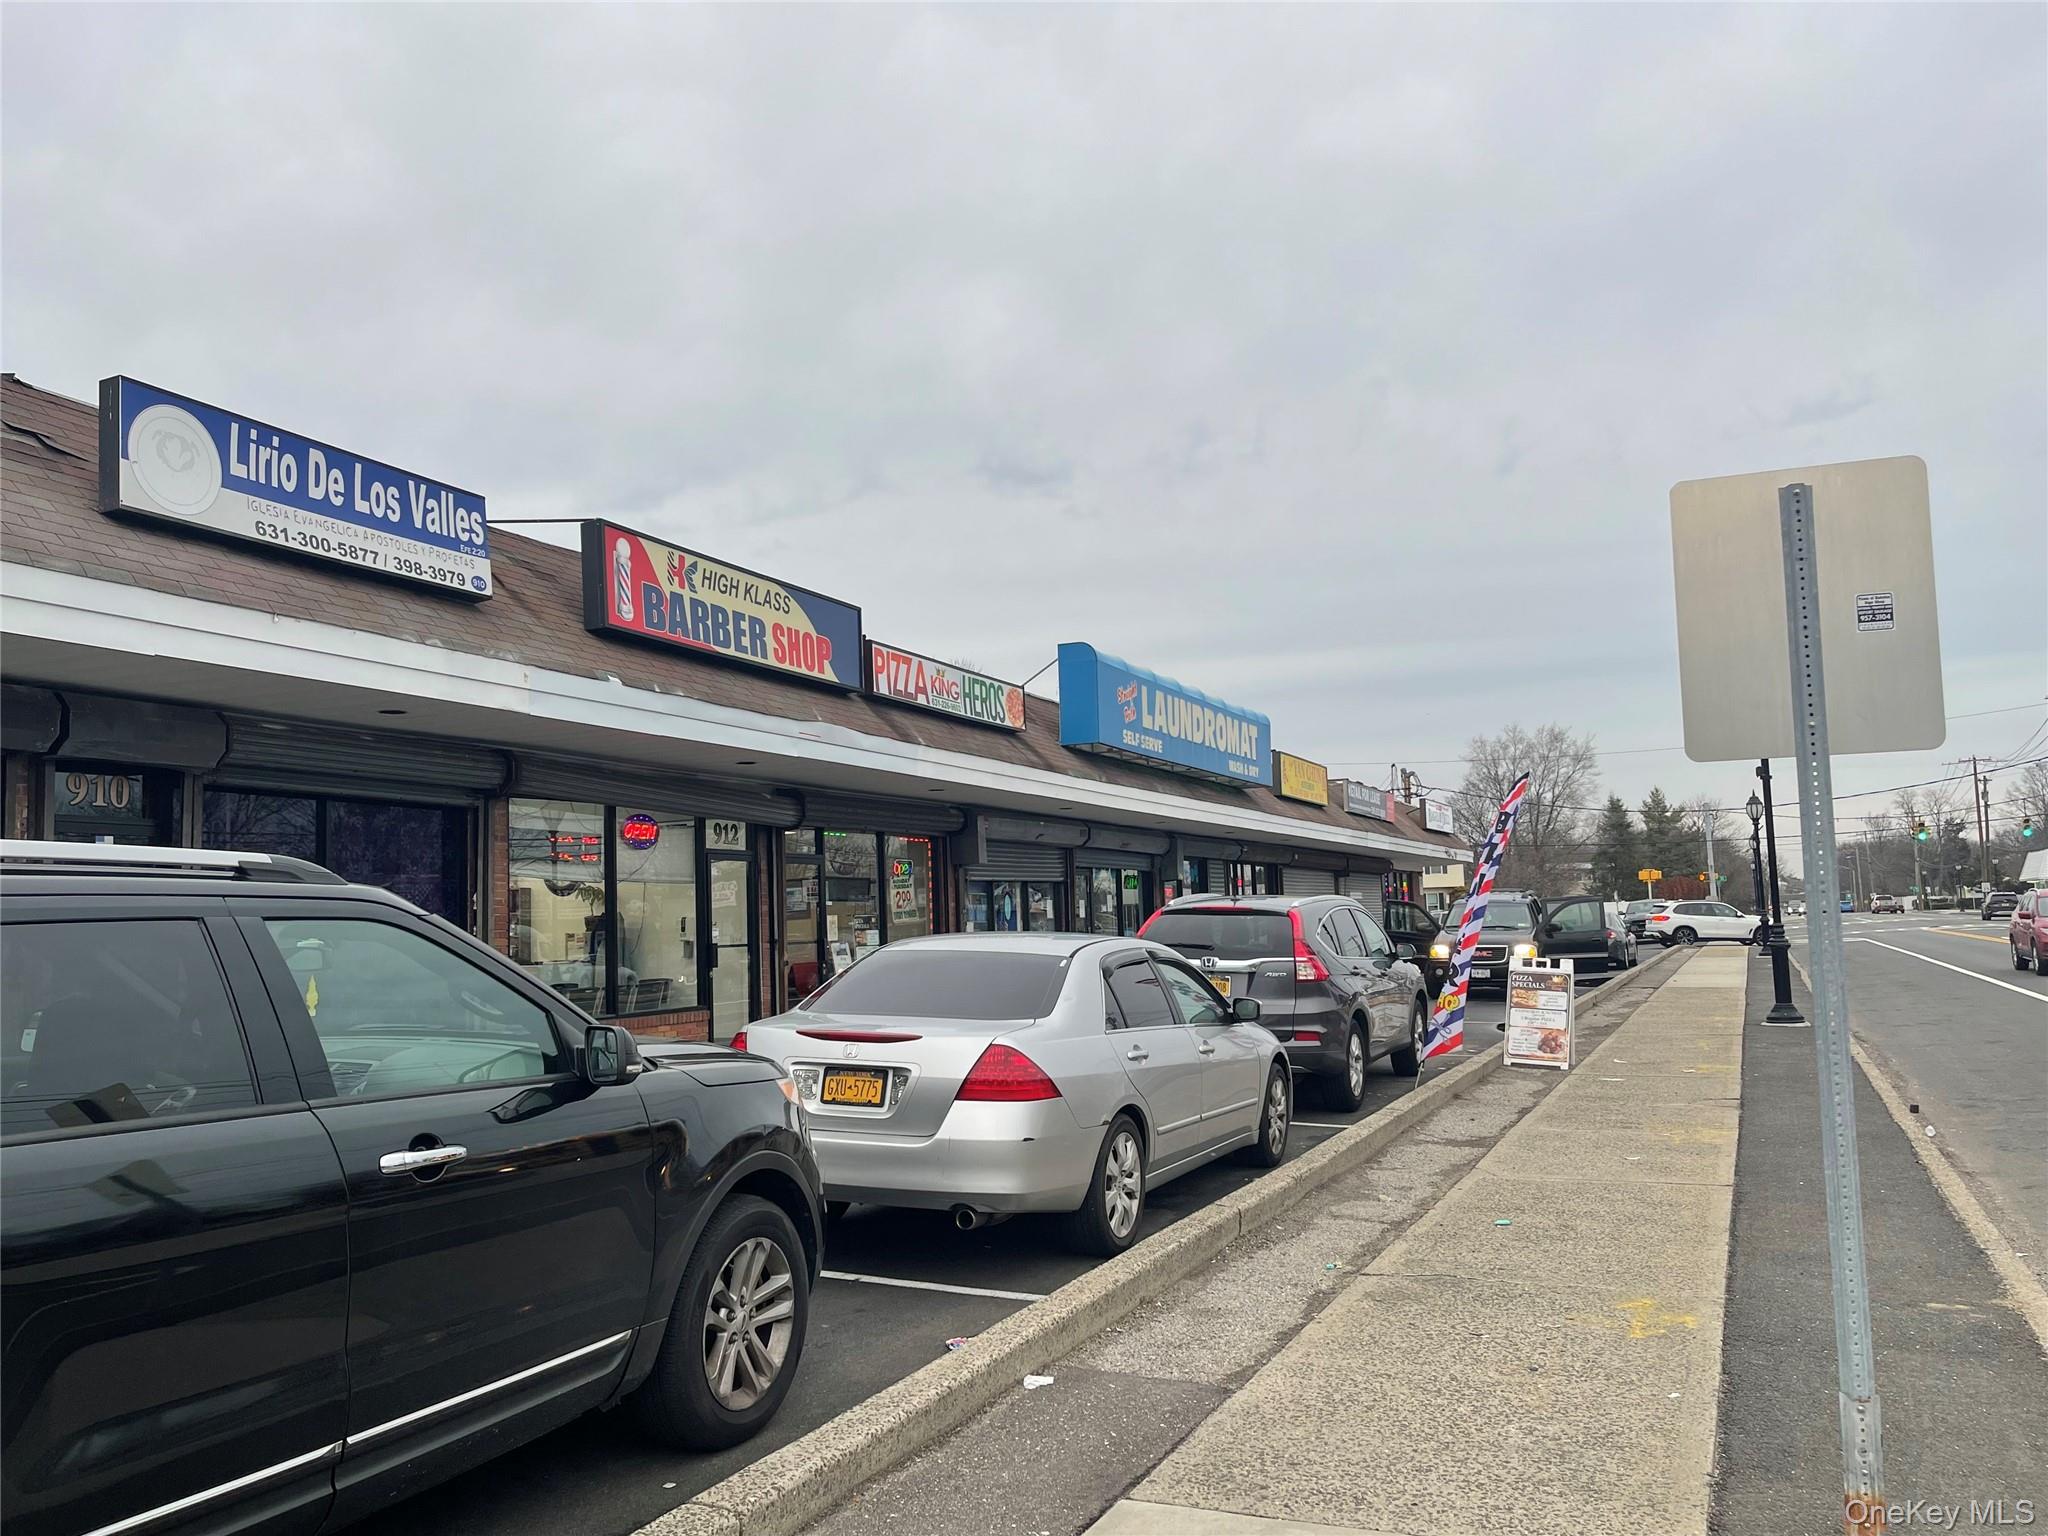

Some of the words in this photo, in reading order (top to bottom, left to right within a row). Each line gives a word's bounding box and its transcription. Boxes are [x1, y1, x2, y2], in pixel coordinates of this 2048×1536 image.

[229, 422, 298, 493] Lirio
[308, 447, 345, 506] De
[354, 462, 401, 523] Los
[408, 479, 485, 545] Valles
[254, 520, 379, 565] 631-300-5877
[393, 556, 466, 586] 398-3979
[472, 578, 486, 589] 910
[701, 568, 739, 598] HIGH
[743, 582, 791, 614] KLASS
[642, 582, 768, 660] BARBER
[771, 622, 832, 675] SHOP
[874, 646, 931, 705] PIZZA
[931, 675, 960, 701] KING
[962, 675, 1006, 724] HEROS
[1141, 684, 1258, 761] LAUNDROMAT
[1122, 729, 1140, 747] SELF
[1141, 734, 1164, 754] SERVE
[66, 773, 131, 809] 910
[622, 822, 657, 841] OPEN
[713, 822, 739, 846] 912
[1511, 974, 1533, 982] PIZZA
[1511, 981, 1546, 989] SPECIALS
